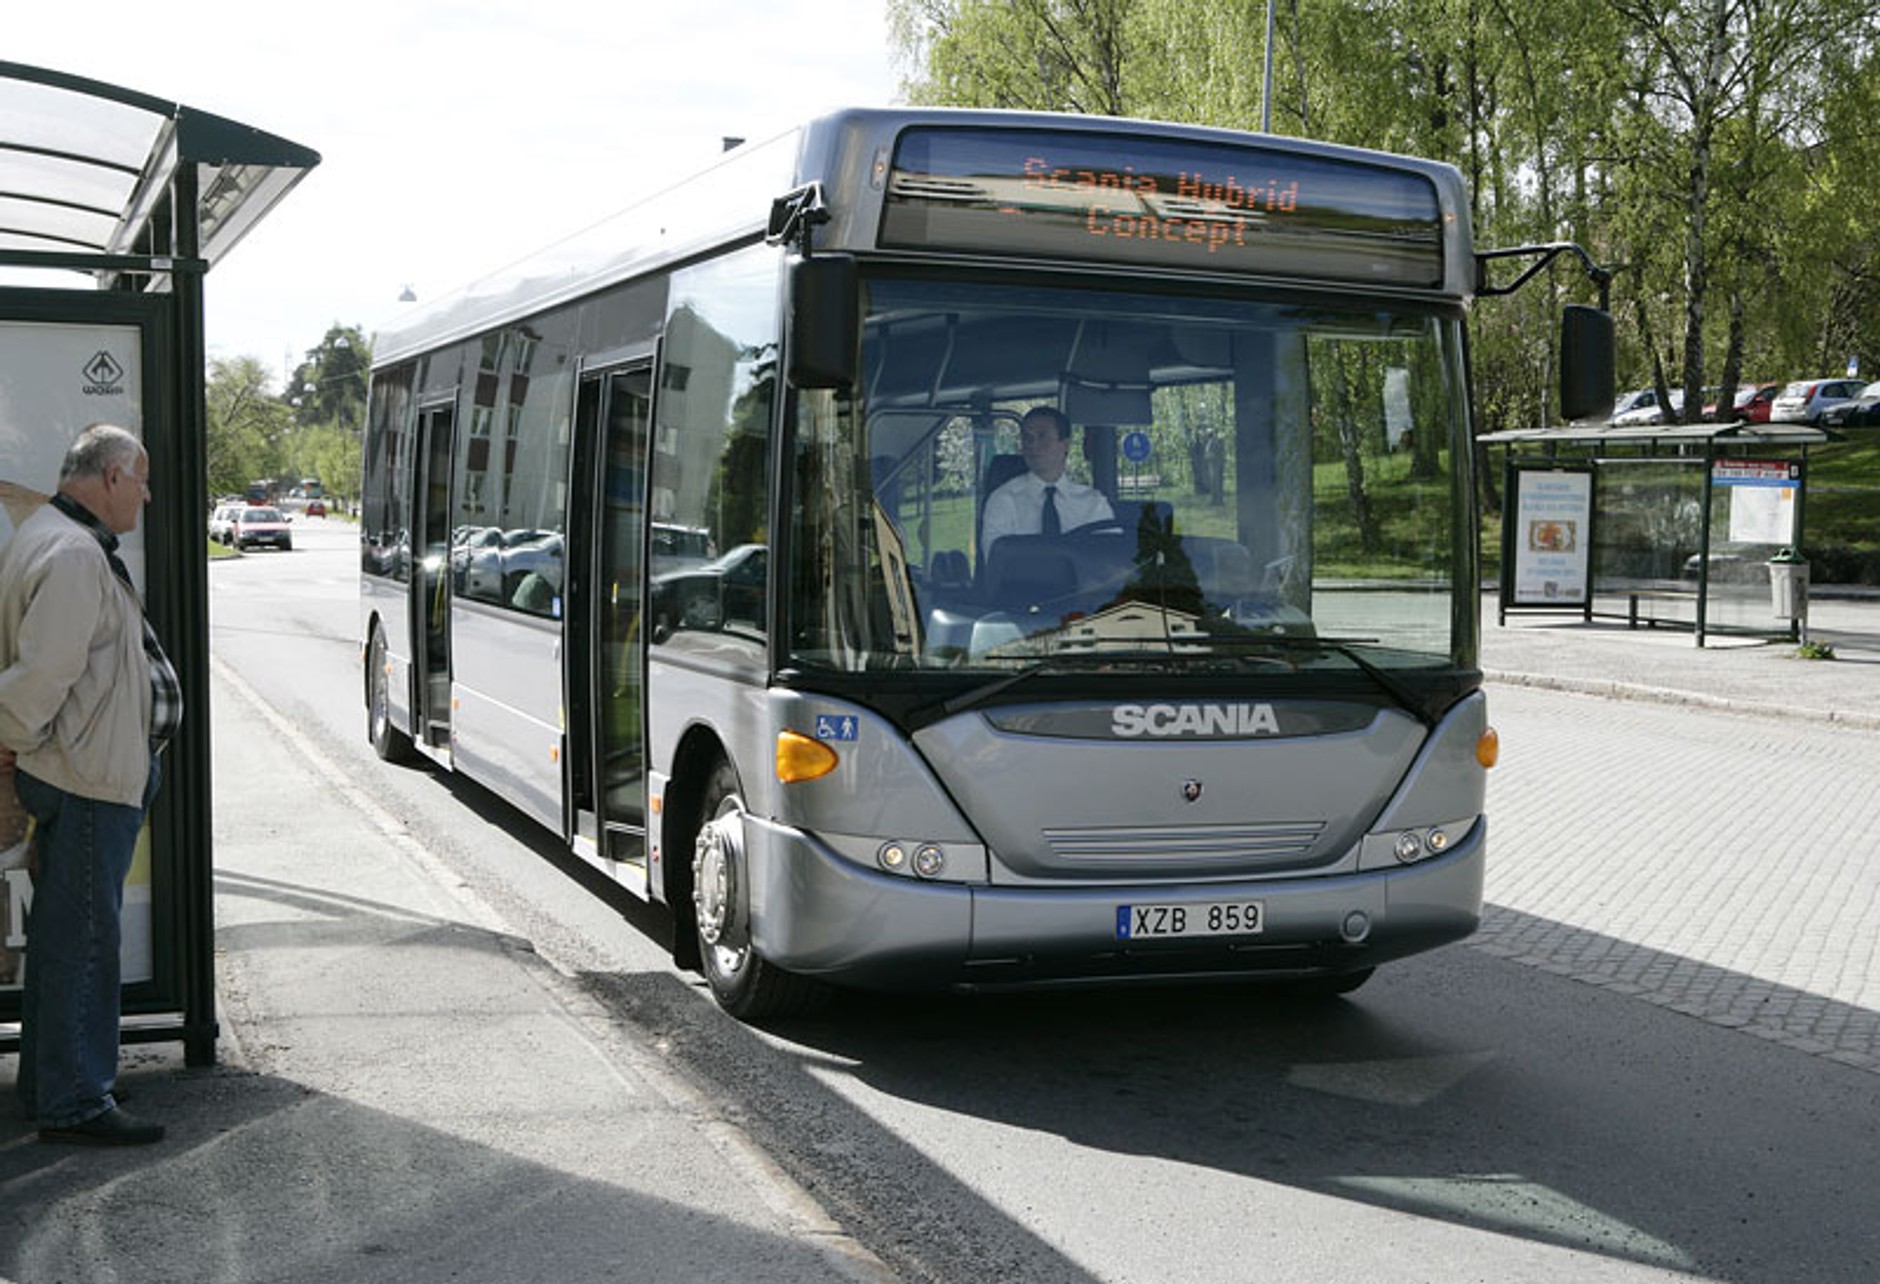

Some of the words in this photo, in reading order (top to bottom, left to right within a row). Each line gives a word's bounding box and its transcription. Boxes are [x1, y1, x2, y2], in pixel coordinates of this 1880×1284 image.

[1023, 157, 1157, 191] Scania
[1177, 171, 1299, 212] Hybrid
[1087, 205, 1247, 252] Concept
[1111, 703, 1279, 736] SCANIA
[1135, 907, 1187, 934] XZB
[1207, 905, 1259, 931] 859
